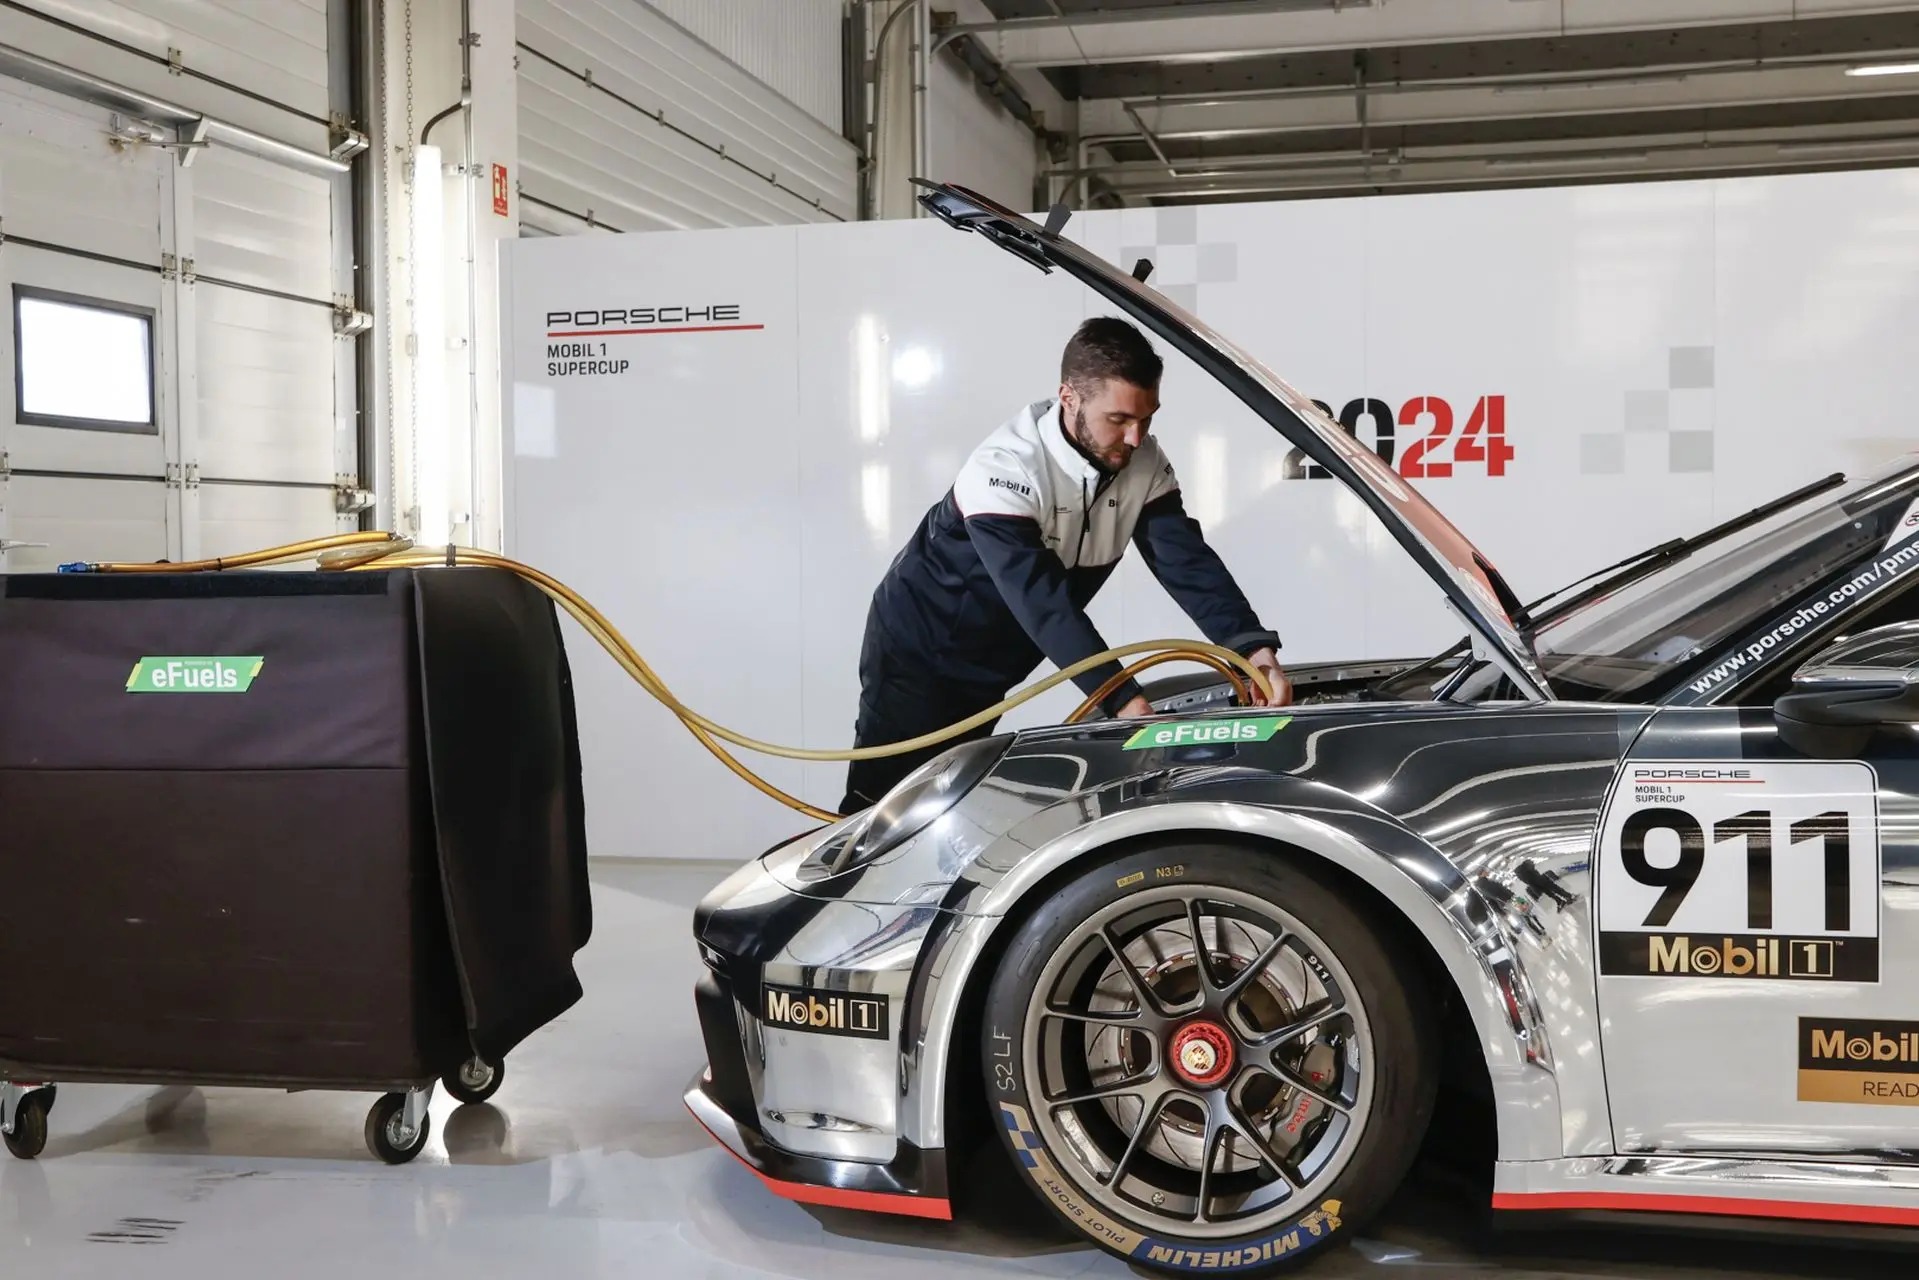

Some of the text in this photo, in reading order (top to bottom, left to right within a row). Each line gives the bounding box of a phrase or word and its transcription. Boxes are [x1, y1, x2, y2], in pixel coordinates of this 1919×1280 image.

[547, 305, 740, 327] PORSCHE
[547, 343, 607, 359] MOBIL 1
[547, 360, 629, 376] SUPERCUP
[989, 478, 1020, 491] Mobil
[151, 661, 238, 688] eFuels
[1154, 721, 1258, 744] eFuels
[1634, 769, 1751, 779] PORSCHE
[1635, 786, 1664, 794] MOBIL
[1635, 794, 1685, 803] SUPERCUP
[1620, 807, 1850, 931] 911
[1308, 955, 1330, 980] 911
[1649, 936, 1779, 975] Mobil
[768, 990, 844, 1029] Mobil
[1811, 1029, 1919, 1062] Mobil
[1044, 1176, 1126, 1244] PILOT SPORT
[1147, 1230, 1301, 1268] MICHELIN
